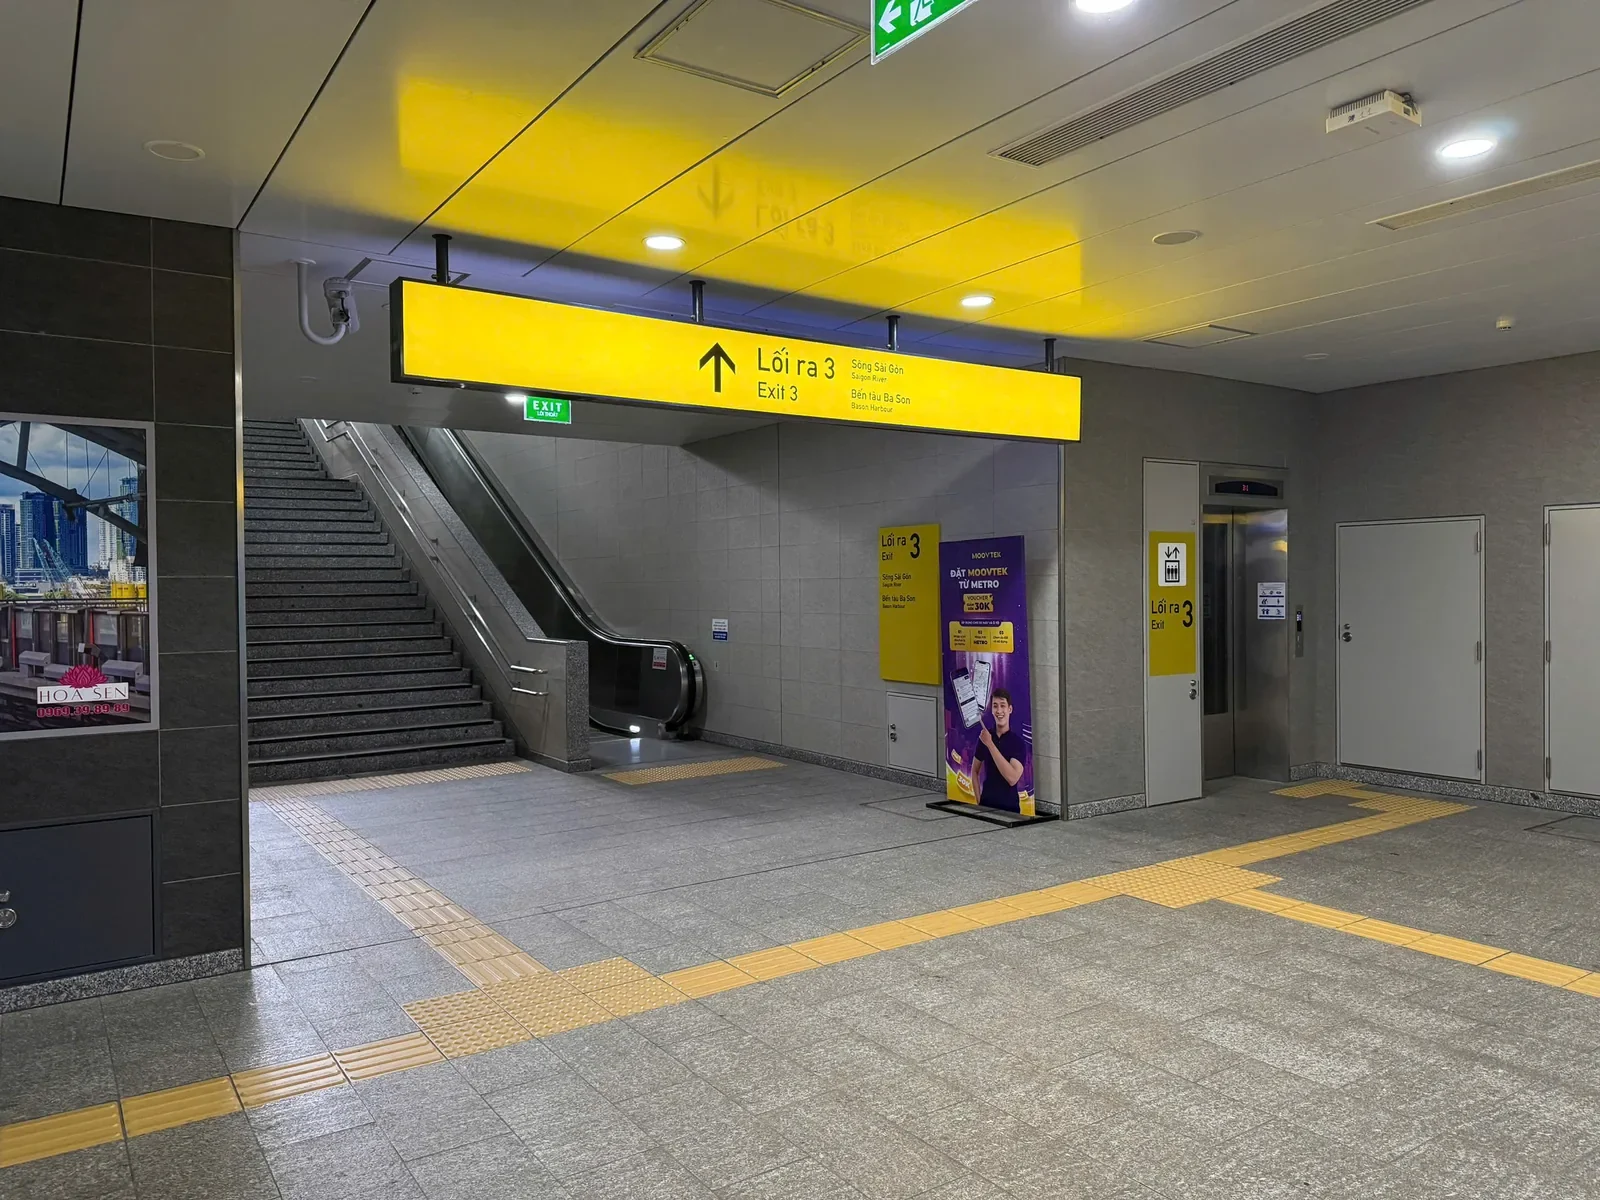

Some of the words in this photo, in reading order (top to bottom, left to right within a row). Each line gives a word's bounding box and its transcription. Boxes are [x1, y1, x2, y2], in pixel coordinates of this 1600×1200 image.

[758, 347, 788, 374] Lối
[798, 359, 818, 378] ra
[824, 358, 835, 379] 3
[852, 359, 872, 373] Sông
[874, 362, 886, 372] Sài
[889, 364, 904, 374] Gòn
[852, 372, 871, 382] Saigon
[758, 382, 784, 400] Exit
[790, 386, 798, 401] 3
[852, 388, 866, 399] Bến
[869, 391, 881, 401] tàu
[884, 393, 893, 402] Ba
[896, 394, 910, 404] Son
[533, 400, 562, 412] EXIT
[870, 404, 893, 412] Harbour
[882, 532, 894, 547] Lối
[897, 536, 906, 546] ra
[910, 533, 920, 558] 3
[882, 552, 893, 560] Exit
[950, 567, 966, 579] ĐẶT
[968, 567, 1008, 577] MOOVTEK
[959, 579, 970, 589] TỪ
[971, 580, 999, 588] METRO
[975, 602, 990, 610] 30K
[1152, 598, 1166, 614] Lối
[1170, 604, 1179, 613] ra
[1182, 600, 1192, 627] 3
[1152, 620, 1164, 629] Exit
[40, 690, 83, 702] HOA
[93, 686, 126, 699] SEN
